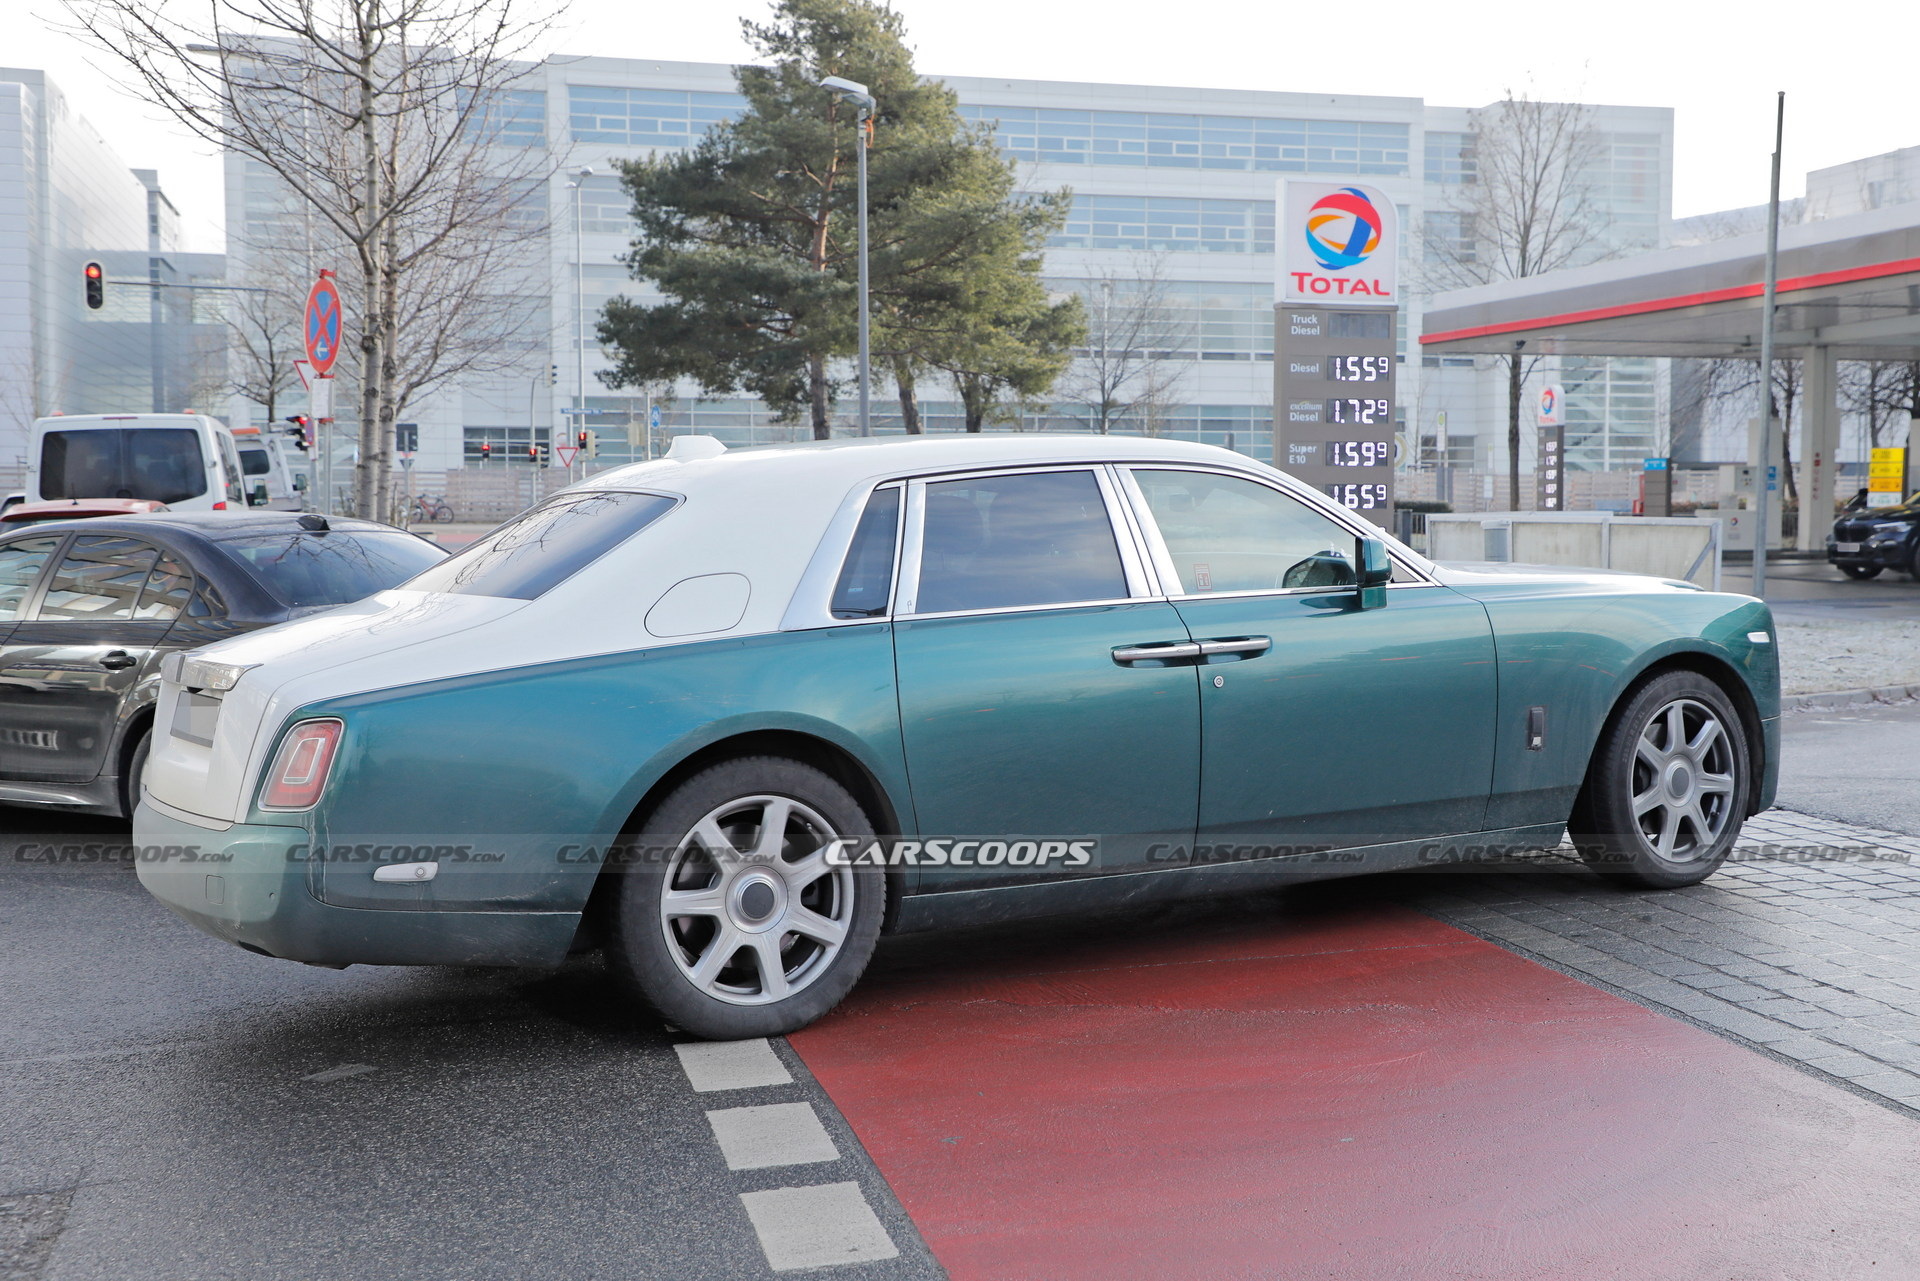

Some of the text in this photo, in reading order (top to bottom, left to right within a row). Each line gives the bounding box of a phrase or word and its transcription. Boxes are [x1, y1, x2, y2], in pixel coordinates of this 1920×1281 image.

[1290, 272, 1390, 296] TOTAL
[1291, 314, 1318, 324] Truck
[1291, 325, 1320, 335] Diesel
[1290, 363, 1319, 373] Diesel
[1289, 412, 1318, 421] Diesel
[1289, 443, 1317, 455] Super
[1289, 455, 1306, 464] E10
